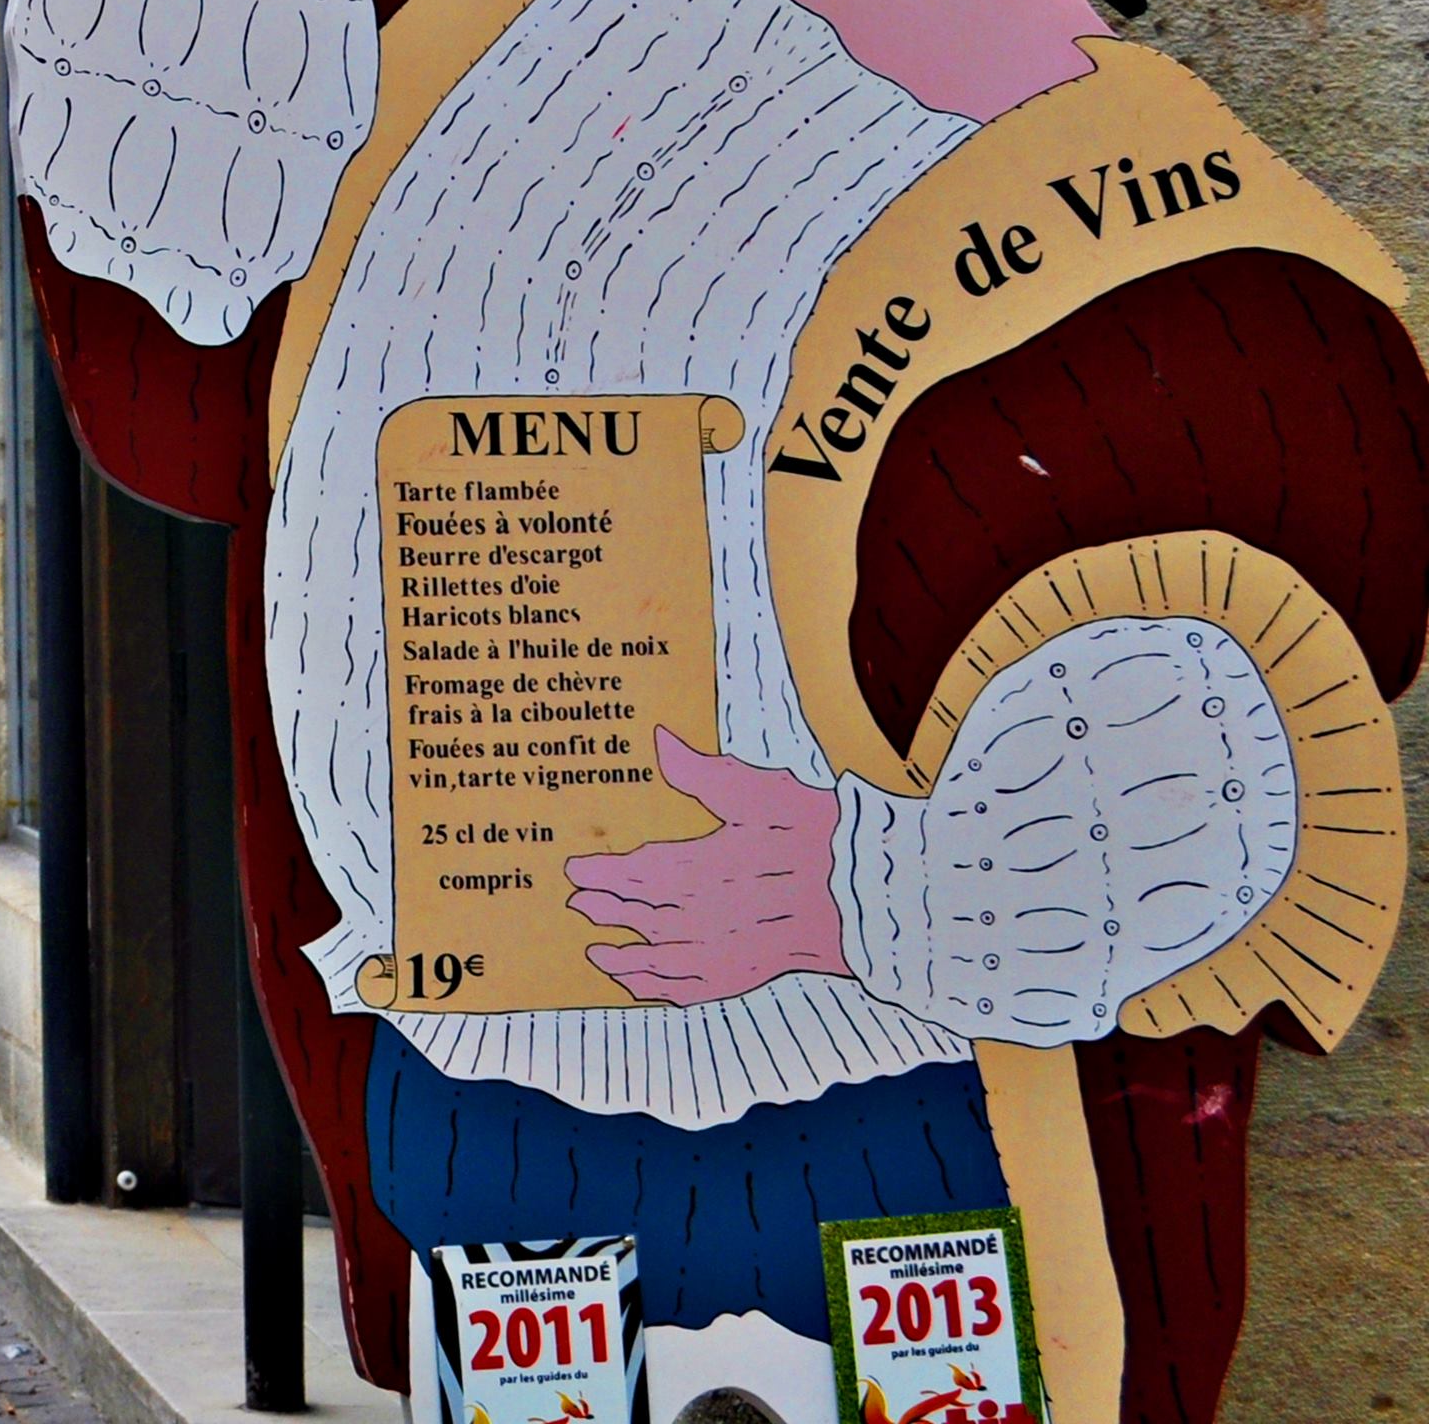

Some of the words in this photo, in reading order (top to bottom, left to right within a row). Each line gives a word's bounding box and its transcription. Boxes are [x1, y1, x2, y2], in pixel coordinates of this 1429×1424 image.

[768, 296, 931, 483] Vente
[954, 221, 1043, 297] de
[1047, 149, 1241, 240] Vins
[449, 411, 641, 456] MENU
[393, 481, 457, 502] Tarte
[464, 479, 560, 501] flambée
[396, 510, 486, 537] Fouées
[495, 510, 510, 535] à
[518, 508, 613, 535] volonté
[399, 546, 481, 567] Beurre
[488, 544, 603, 570] d'escargot
[401, 576, 503, 598] Rillettes
[510, 573, 561, 596] d'oie
[402, 605, 502, 627] Haricots
[508, 604, 581, 625] blancs
[403, 639, 480, 661] Salade
[487, 638, 500, 660] à
[508, 637, 579, 660] l'huile
[586, 637, 613, 658] de
[621, 635, 670, 657] noix
[404, 674, 505, 700] Fromage
[512, 672, 539, 694] de
[546, 670, 622, 692] chèvre
[408, 703, 463, 725] frais
[470, 702, 483, 724] à
[491, 702, 513, 724] la
[520, 700, 635, 723] ciboulette
[408, 737, 485, 760] Fouées
[492, 742, 520, 758] au
[527, 734, 596, 757] confit
[604, 733, 630, 755] de
[409, 767, 516, 793] vin,tarte
[522, 764, 654, 792] vigneronne
[421, 823, 448, 845] 25
[455, 823, 475, 844] cl
[482, 822, 509, 844] de
[515, 821, 554, 843] vin
[439, 867, 533, 896] compris
[406, 952, 484, 1001] 19€
[851, 1233, 999, 1266] RECOMMANDÉ
[461, 1261, 611, 1290] RECOMMANDÉ
[890, 1261, 964, 1279] millésime
[500, 1287, 576, 1304] millésime
[859, 1276, 1002, 1345] 2013
[468, 1303, 608, 1371] 2011
[891, 1349, 909, 1360] par
[911, 1346, 926, 1357] les
[928, 1344, 964, 1358] guides
[965, 1342, 980, 1352] du
[499, 1375, 518, 1386] par
[519, 1373, 535, 1384] les
[537, 1371, 572, 1384] guides
[574, 1369, 589, 1379] du
